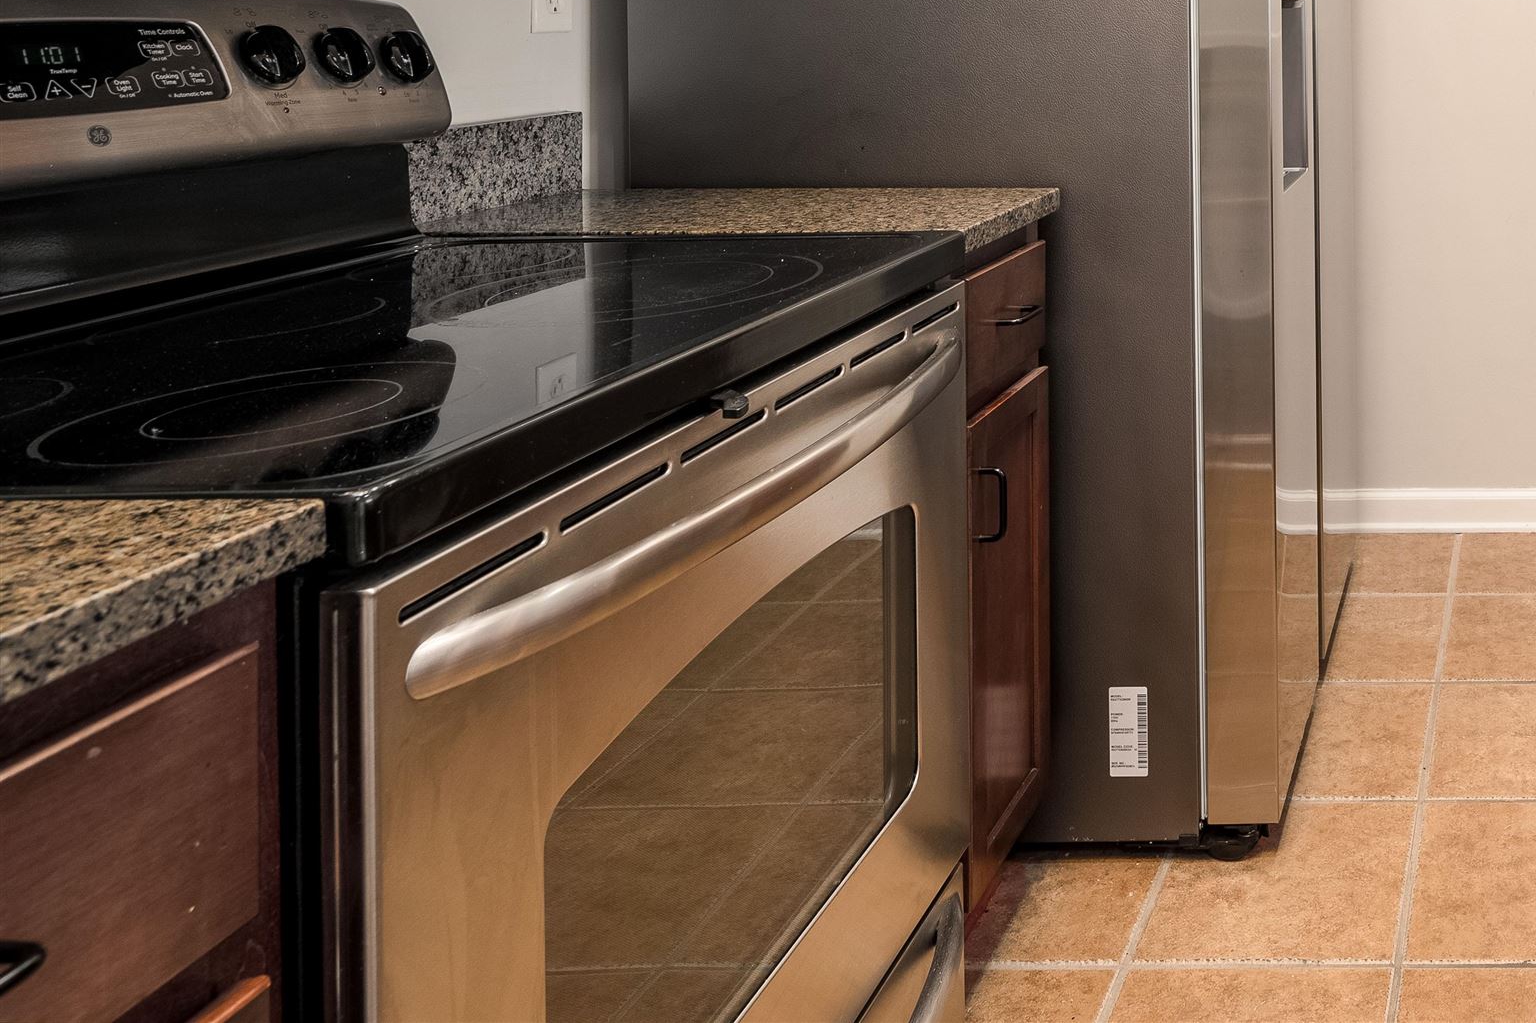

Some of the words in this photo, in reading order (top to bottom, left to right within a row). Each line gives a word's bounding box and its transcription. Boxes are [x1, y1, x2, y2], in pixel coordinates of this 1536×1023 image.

[175, 43, 194, 51] Clock
[22, 46, 81, 65] 11:01
[155, 72, 179, 81] Cooking
[7, 84, 22, 93] Self
[116, 84, 133, 92] Light
[7, 91, 29, 99] Clean
